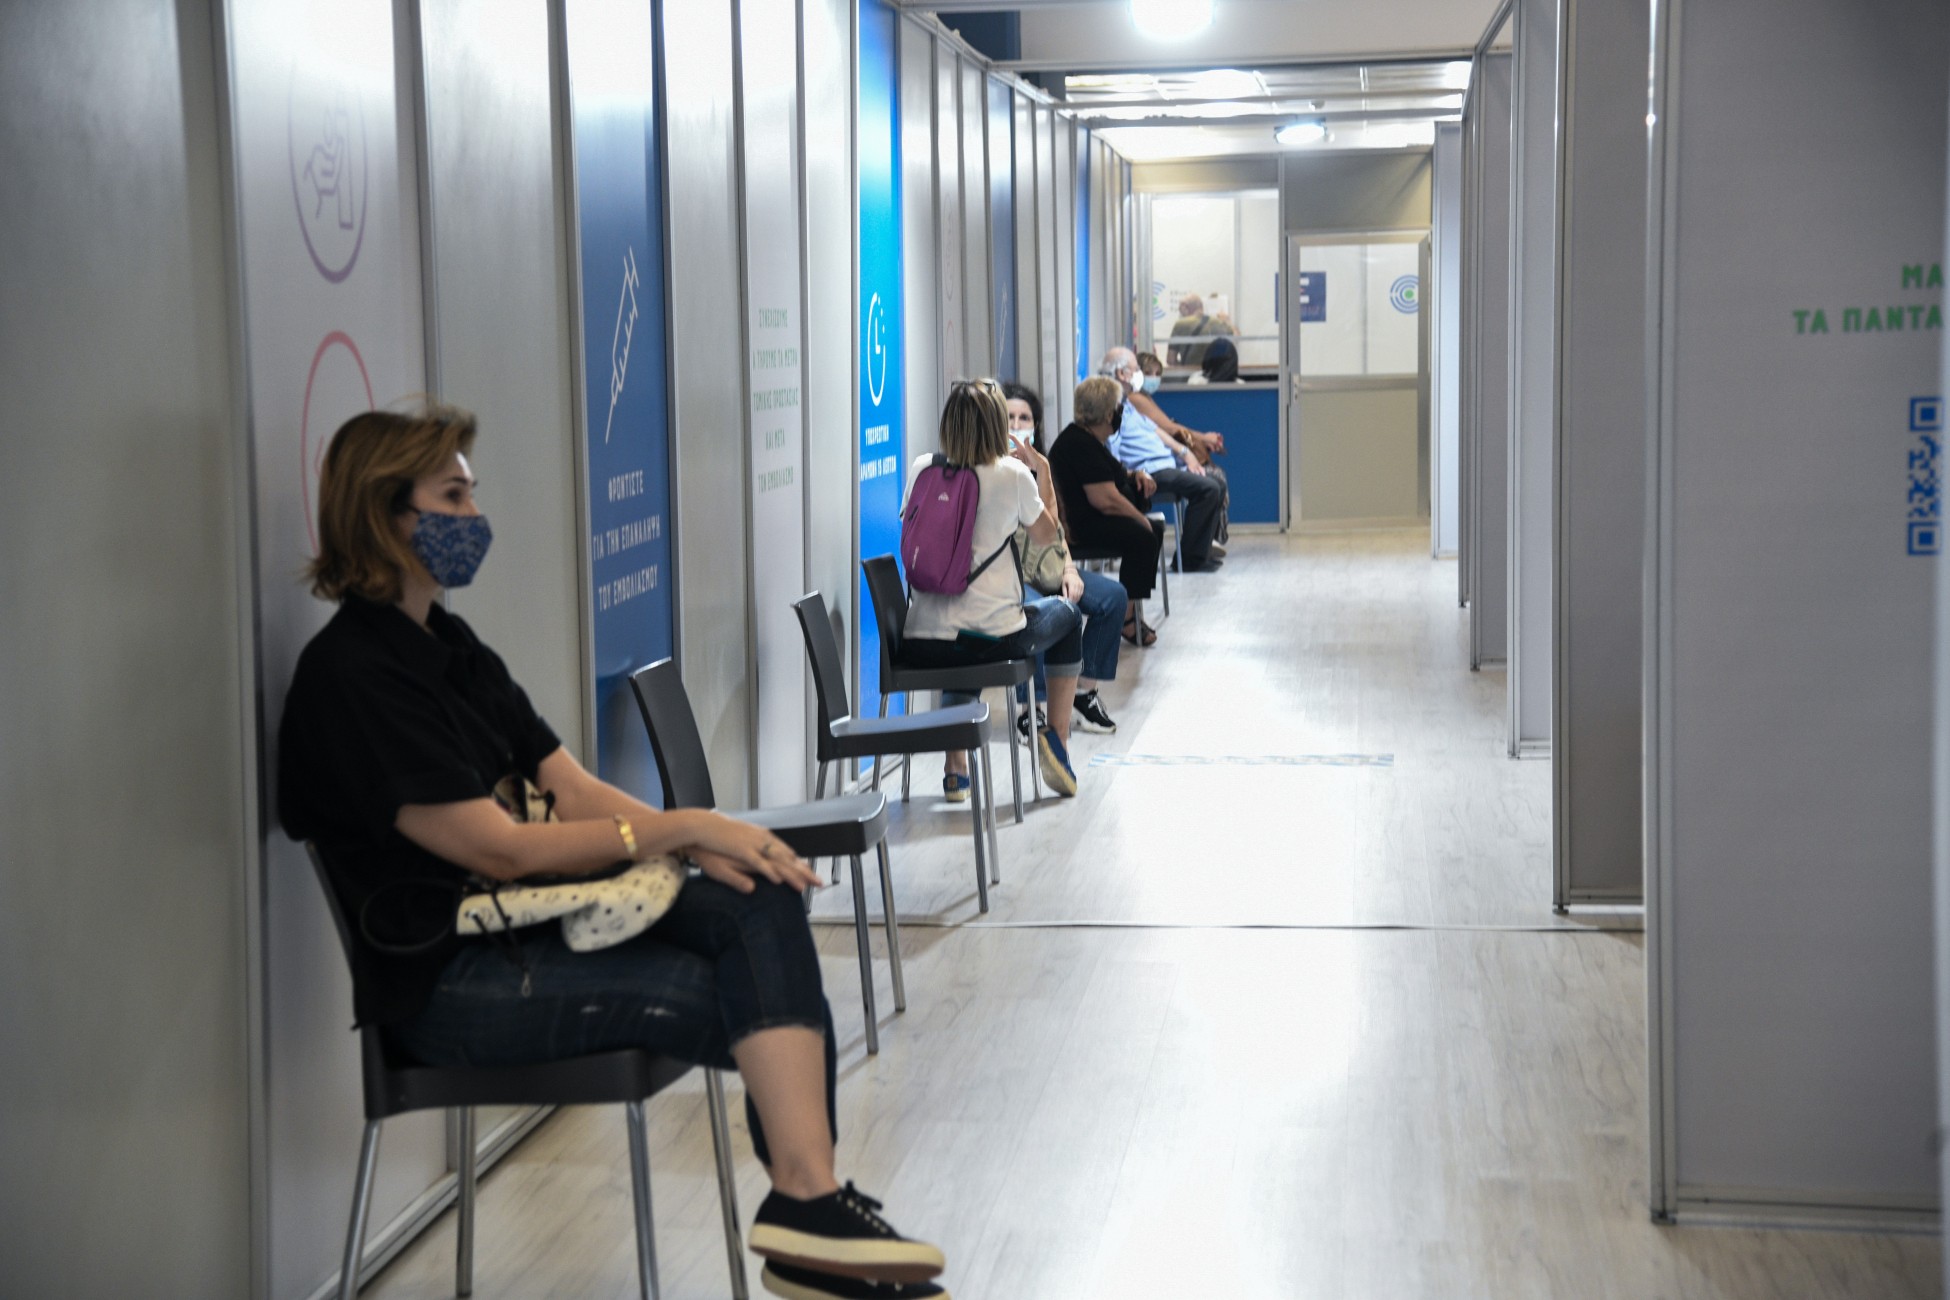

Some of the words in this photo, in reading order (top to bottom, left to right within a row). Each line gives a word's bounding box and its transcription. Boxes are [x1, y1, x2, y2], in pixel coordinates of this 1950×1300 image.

[1792, 307, 1829, 335] ΤΑ
[1842, 304, 1944, 333] ΠΑΝΤΑ
[753, 390, 772, 412] ΤΟΜΙΚΗΣ
[608, 469, 645, 503] ΦΡΟΝΤΙΣΤΕ
[860, 459, 877, 481] ΑΡΑΜΟΝΗ
[592, 533, 605, 561] ΓΙΑ
[606, 528, 620, 556] ΤΗΝ
[621, 514, 661, 551] ΕΠΑΝΑΛΗΨΗ
[598, 581, 611, 612] ΤΟΥ
[613, 564, 659, 606] ΕΜΒΟΛΙΑΣΜΟΥ
